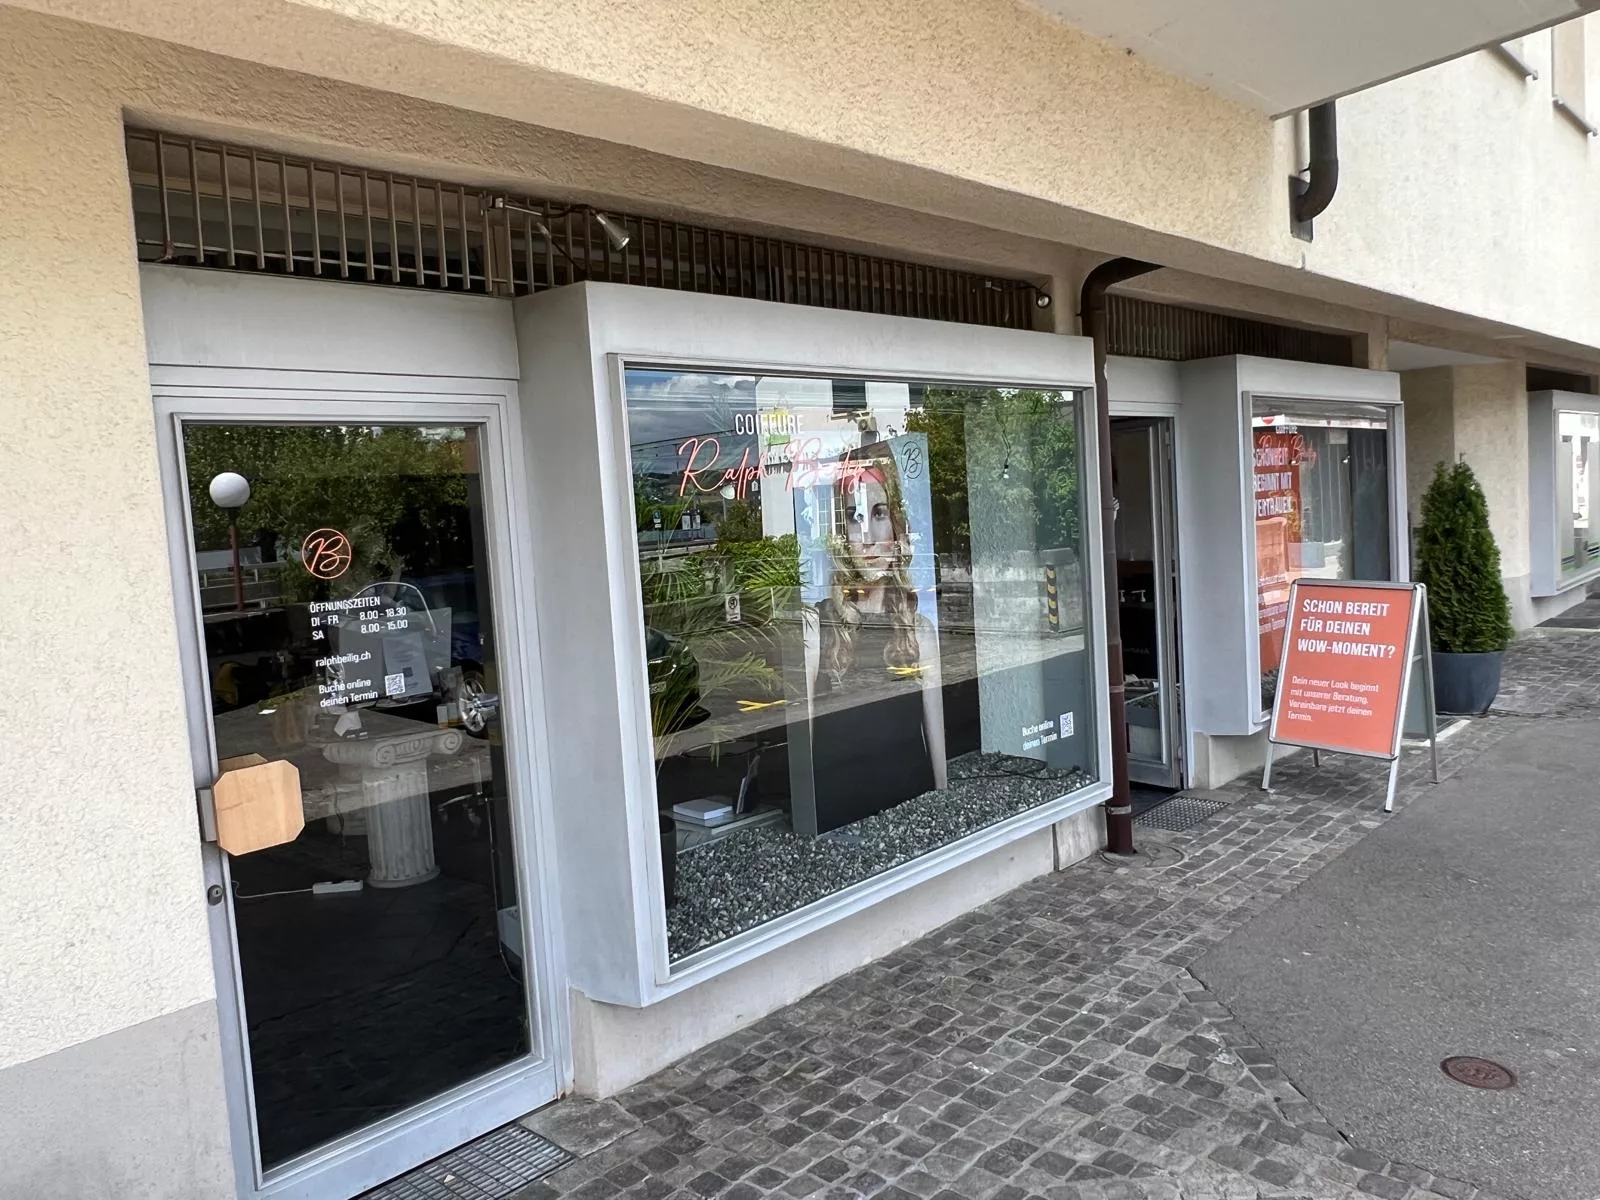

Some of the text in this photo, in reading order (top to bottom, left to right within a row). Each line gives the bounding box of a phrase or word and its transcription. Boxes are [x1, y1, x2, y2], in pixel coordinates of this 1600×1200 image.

[735, 413, 805, 435] COIFFURE
[678, 437, 867, 500] Ralph Blig
[309, 596, 381, 614] ÖFFNUNGSZEITEN
[1303, 598, 1343, 614] SCHON
[1345, 602, 1390, 617] BEREIT
[311, 616, 321, 627] DI
[328, 615, 339, 626] FR
[359, 611, 379, 621] 8.00
[385, 607, 407, 618] 18.30
[1300, 616, 1323, 633] FÜR
[1325, 620, 1371, 636] DEINEN
[312, 631, 325, 641] SA
[361, 623, 380, 634] 8.00
[387, 620, 409, 630] 15.00
[1297, 638, 1396, 659] WOW-MOMENT?
[319, 678, 371, 694] Buche online
[1292, 675, 1379, 693] Dein neuer Look beginnt
[320, 690, 379, 708] deinen Termin
[1290, 688, 1369, 705] mit unserer Beratung.
[1288, 699, 1373, 717] Vereinbare jetzt deinen
[1022, 724, 1038, 737] Buche
[1040, 732, 1057, 745] Termin
